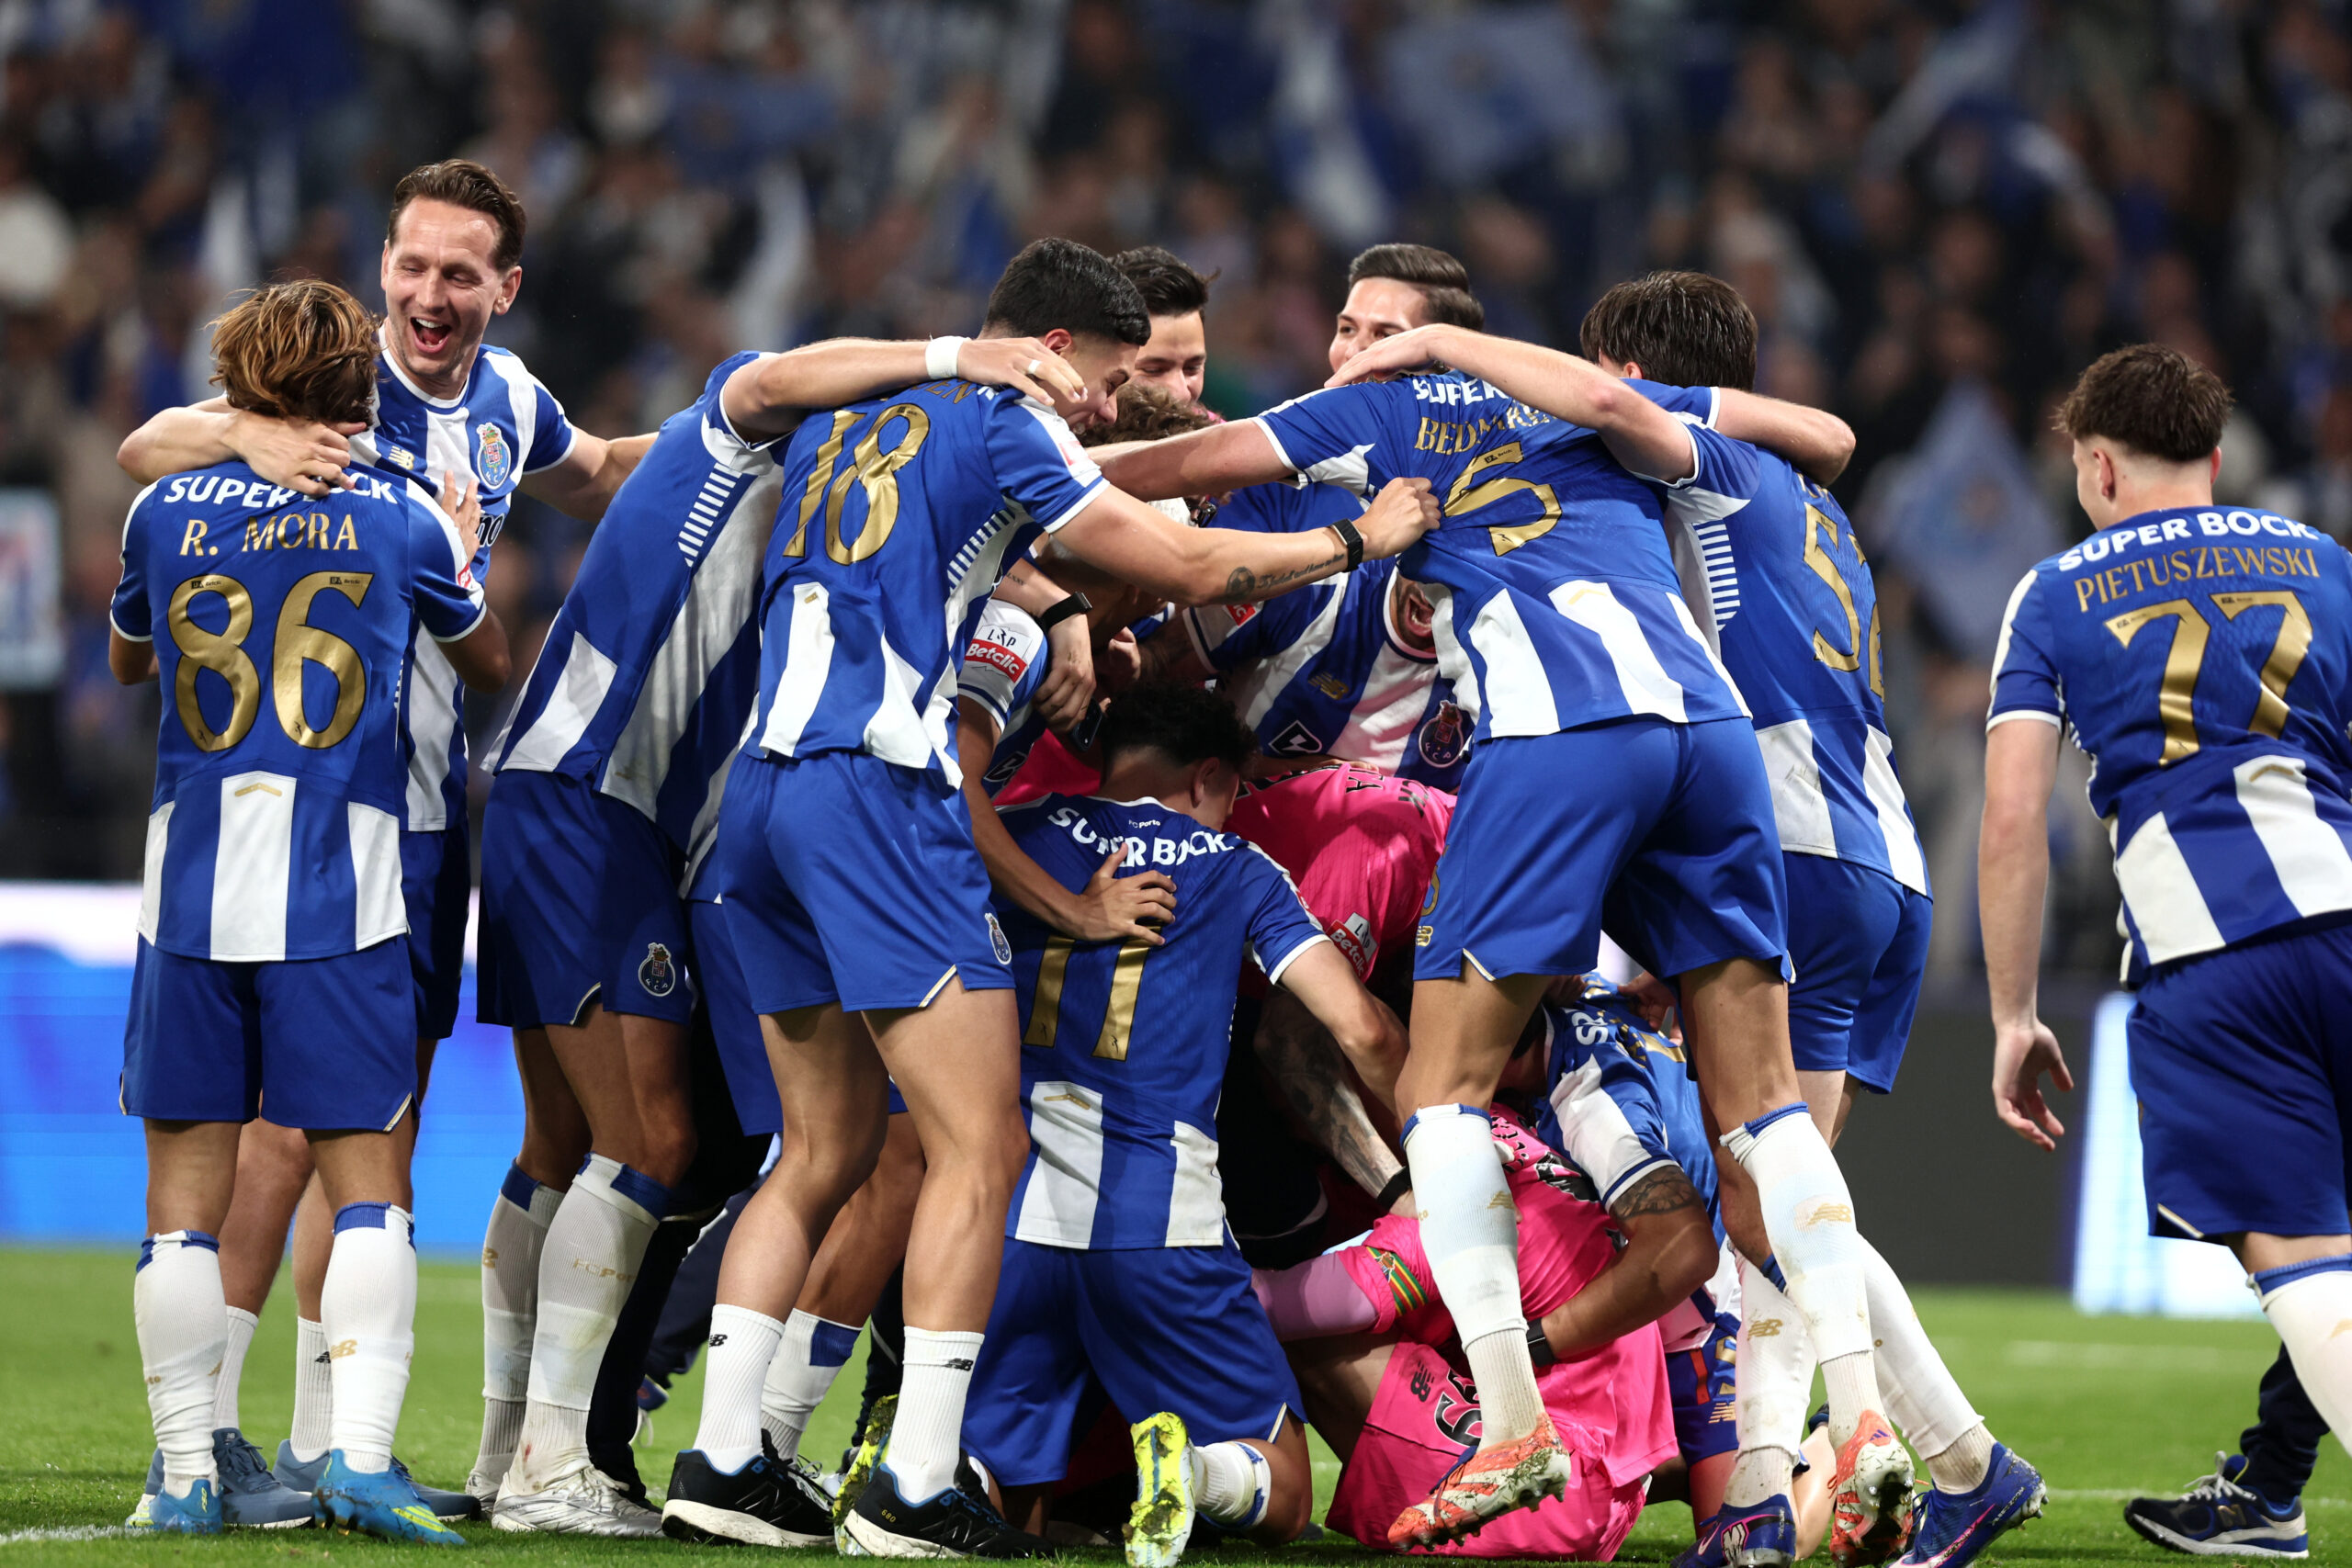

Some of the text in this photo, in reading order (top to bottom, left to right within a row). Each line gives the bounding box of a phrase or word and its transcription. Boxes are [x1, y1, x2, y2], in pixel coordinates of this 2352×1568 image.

[164, 475, 299, 508] SUPER
[782, 402, 931, 565] 18
[179, 512, 359, 557] R. MORA
[2058, 511, 2320, 571] SUPER BOCK
[2074, 546, 2321, 614] PIETUSZEWSKI
[166, 570, 375, 753] 86
[966, 643, 1021, 675] Betclic
[2103, 590, 2313, 765] 77
[1329, 928, 1365, 977] Betclic
[881, 1508, 897, 1523] 680
